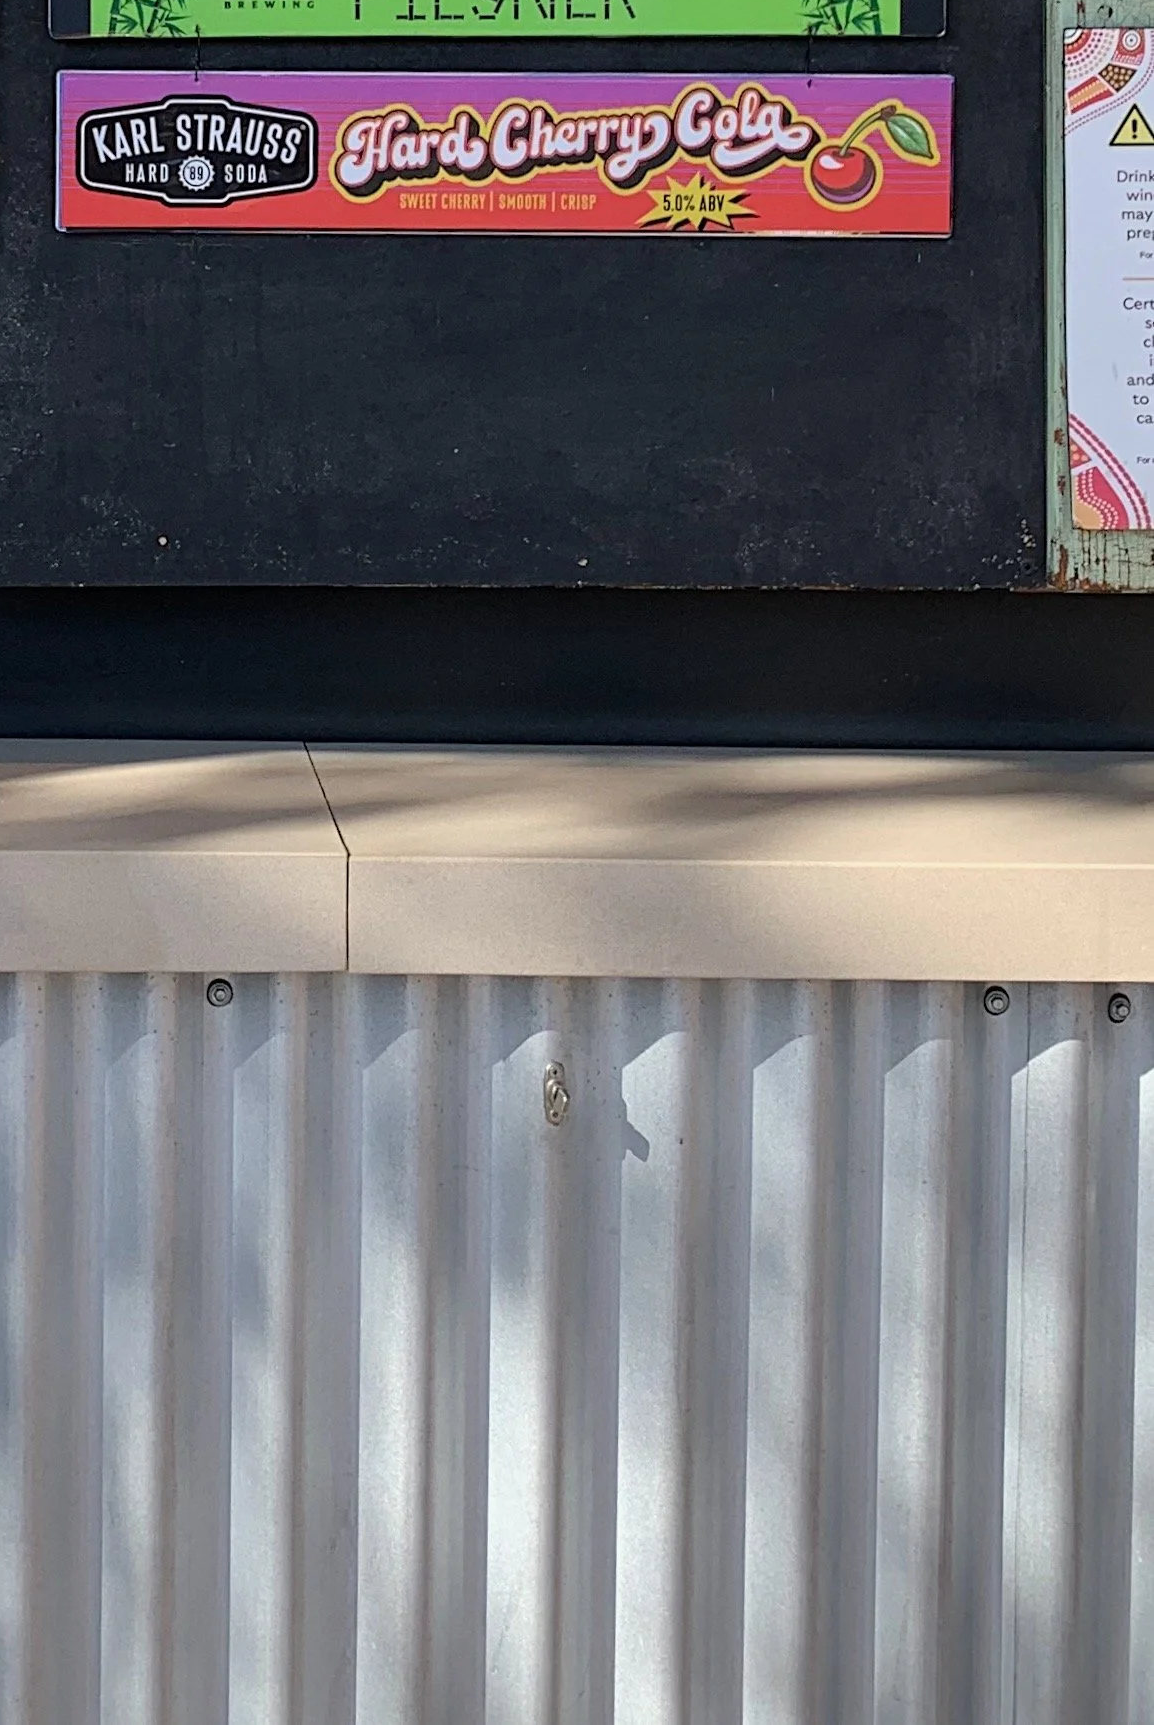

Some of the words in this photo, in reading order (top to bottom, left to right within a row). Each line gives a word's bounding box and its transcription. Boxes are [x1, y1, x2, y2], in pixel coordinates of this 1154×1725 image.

[224, 1, 315, 9] BREWING
[92, 116, 165, 163] KARL
[176, 114, 302, 164] STRAUSS
[335, 109, 489, 188] Hard
[489, 102, 675, 184] Cherry
[674, 87, 819, 172] Cola
[125, 164, 169, 183] HARD
[224, 164, 267, 183] SODA
[399, 193, 437, 209] SWEET
[441, 194, 485, 210] CHERRY
[498, 194, 546, 210] SMOOTH
[560, 194, 597, 211] CRISP
[1127, 189, 1154, 201] win
[662, 194, 695, 212] 5.0%
[699, 194, 725, 212] ABV
[1121, 210, 1153, 222] may
[1139, 251, 1153, 259] For
[1123, 297, 1154, 311] Cert
[1126, 374, 1154, 387] and
[1133, 394, 1149, 405] to
